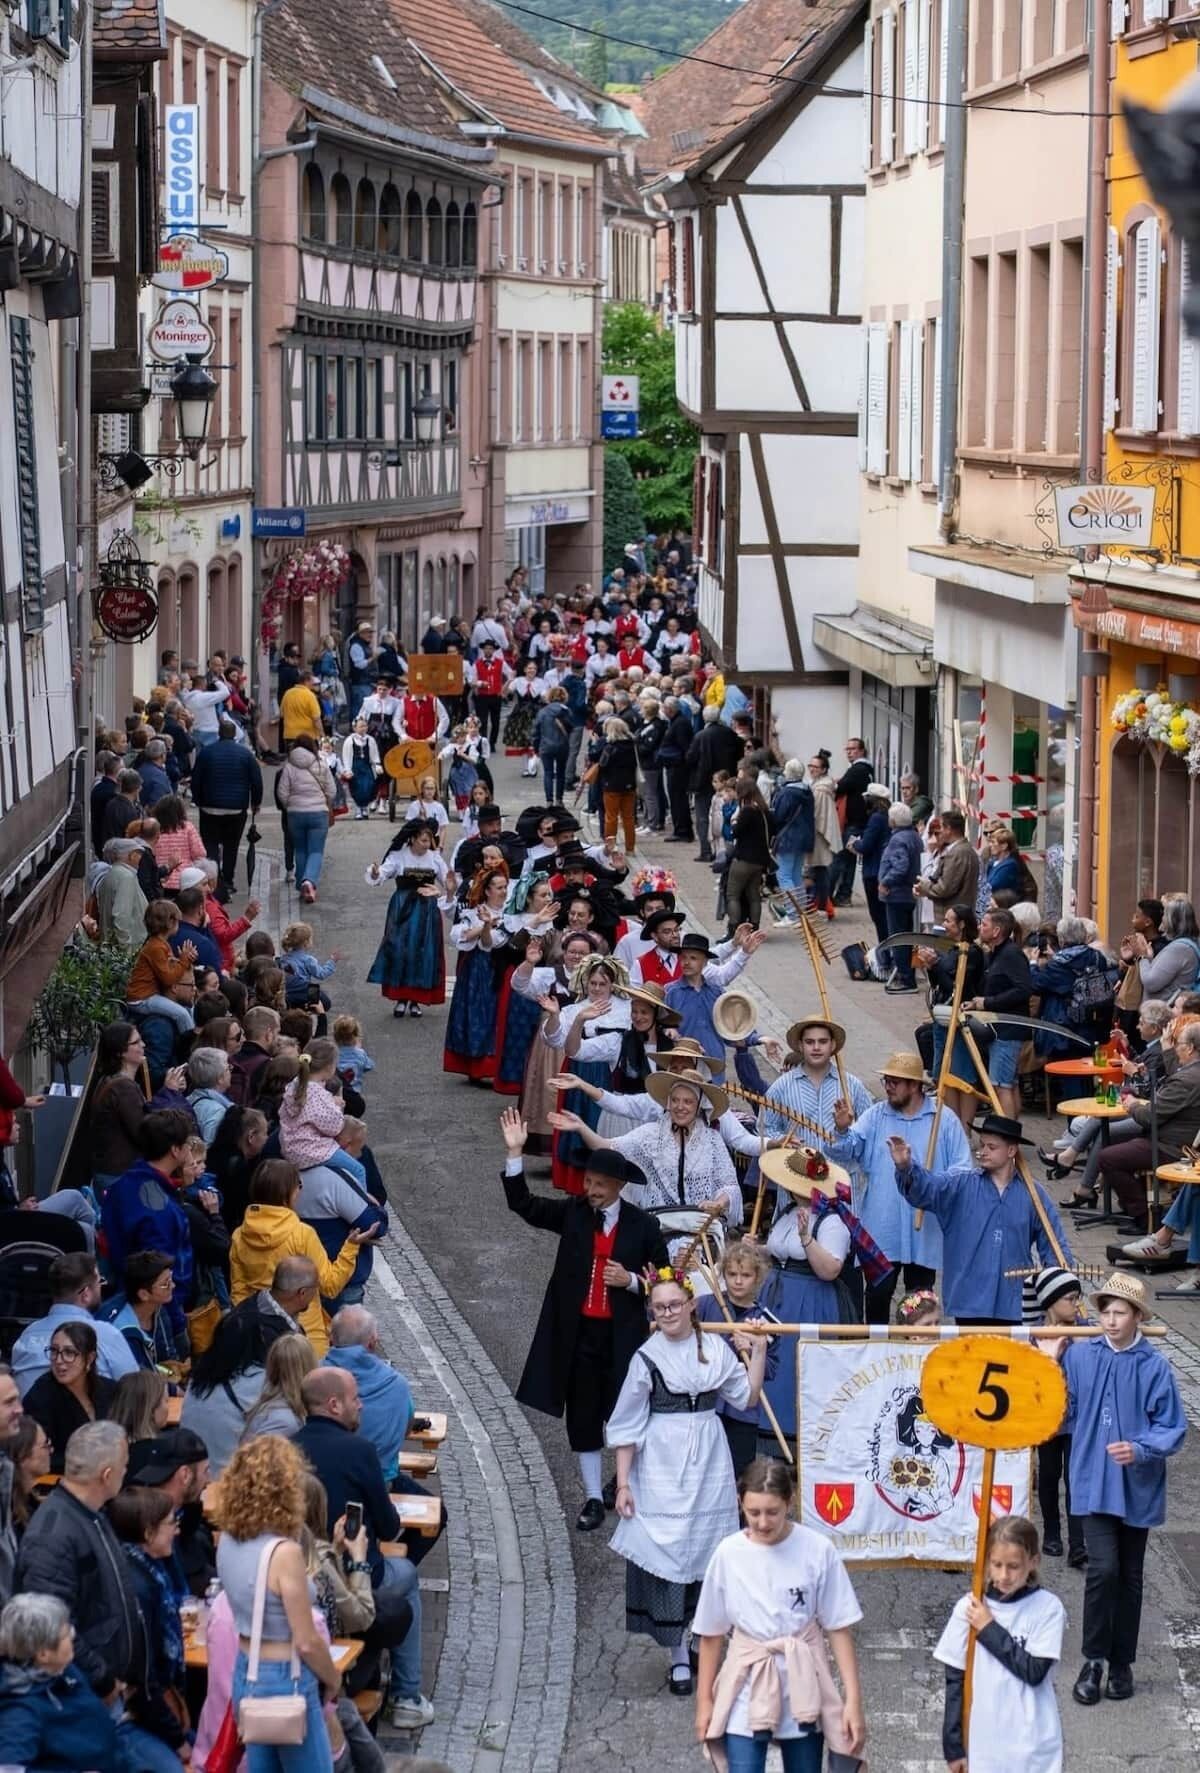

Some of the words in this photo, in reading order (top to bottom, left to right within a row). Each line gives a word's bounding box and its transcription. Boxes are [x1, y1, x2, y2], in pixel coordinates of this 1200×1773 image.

[154, 330, 208, 344] Moninger
[256, 517, 288, 528] Allianz
[402, 748, 415, 769] 6
[974, 1363, 1009, 1422] 5
